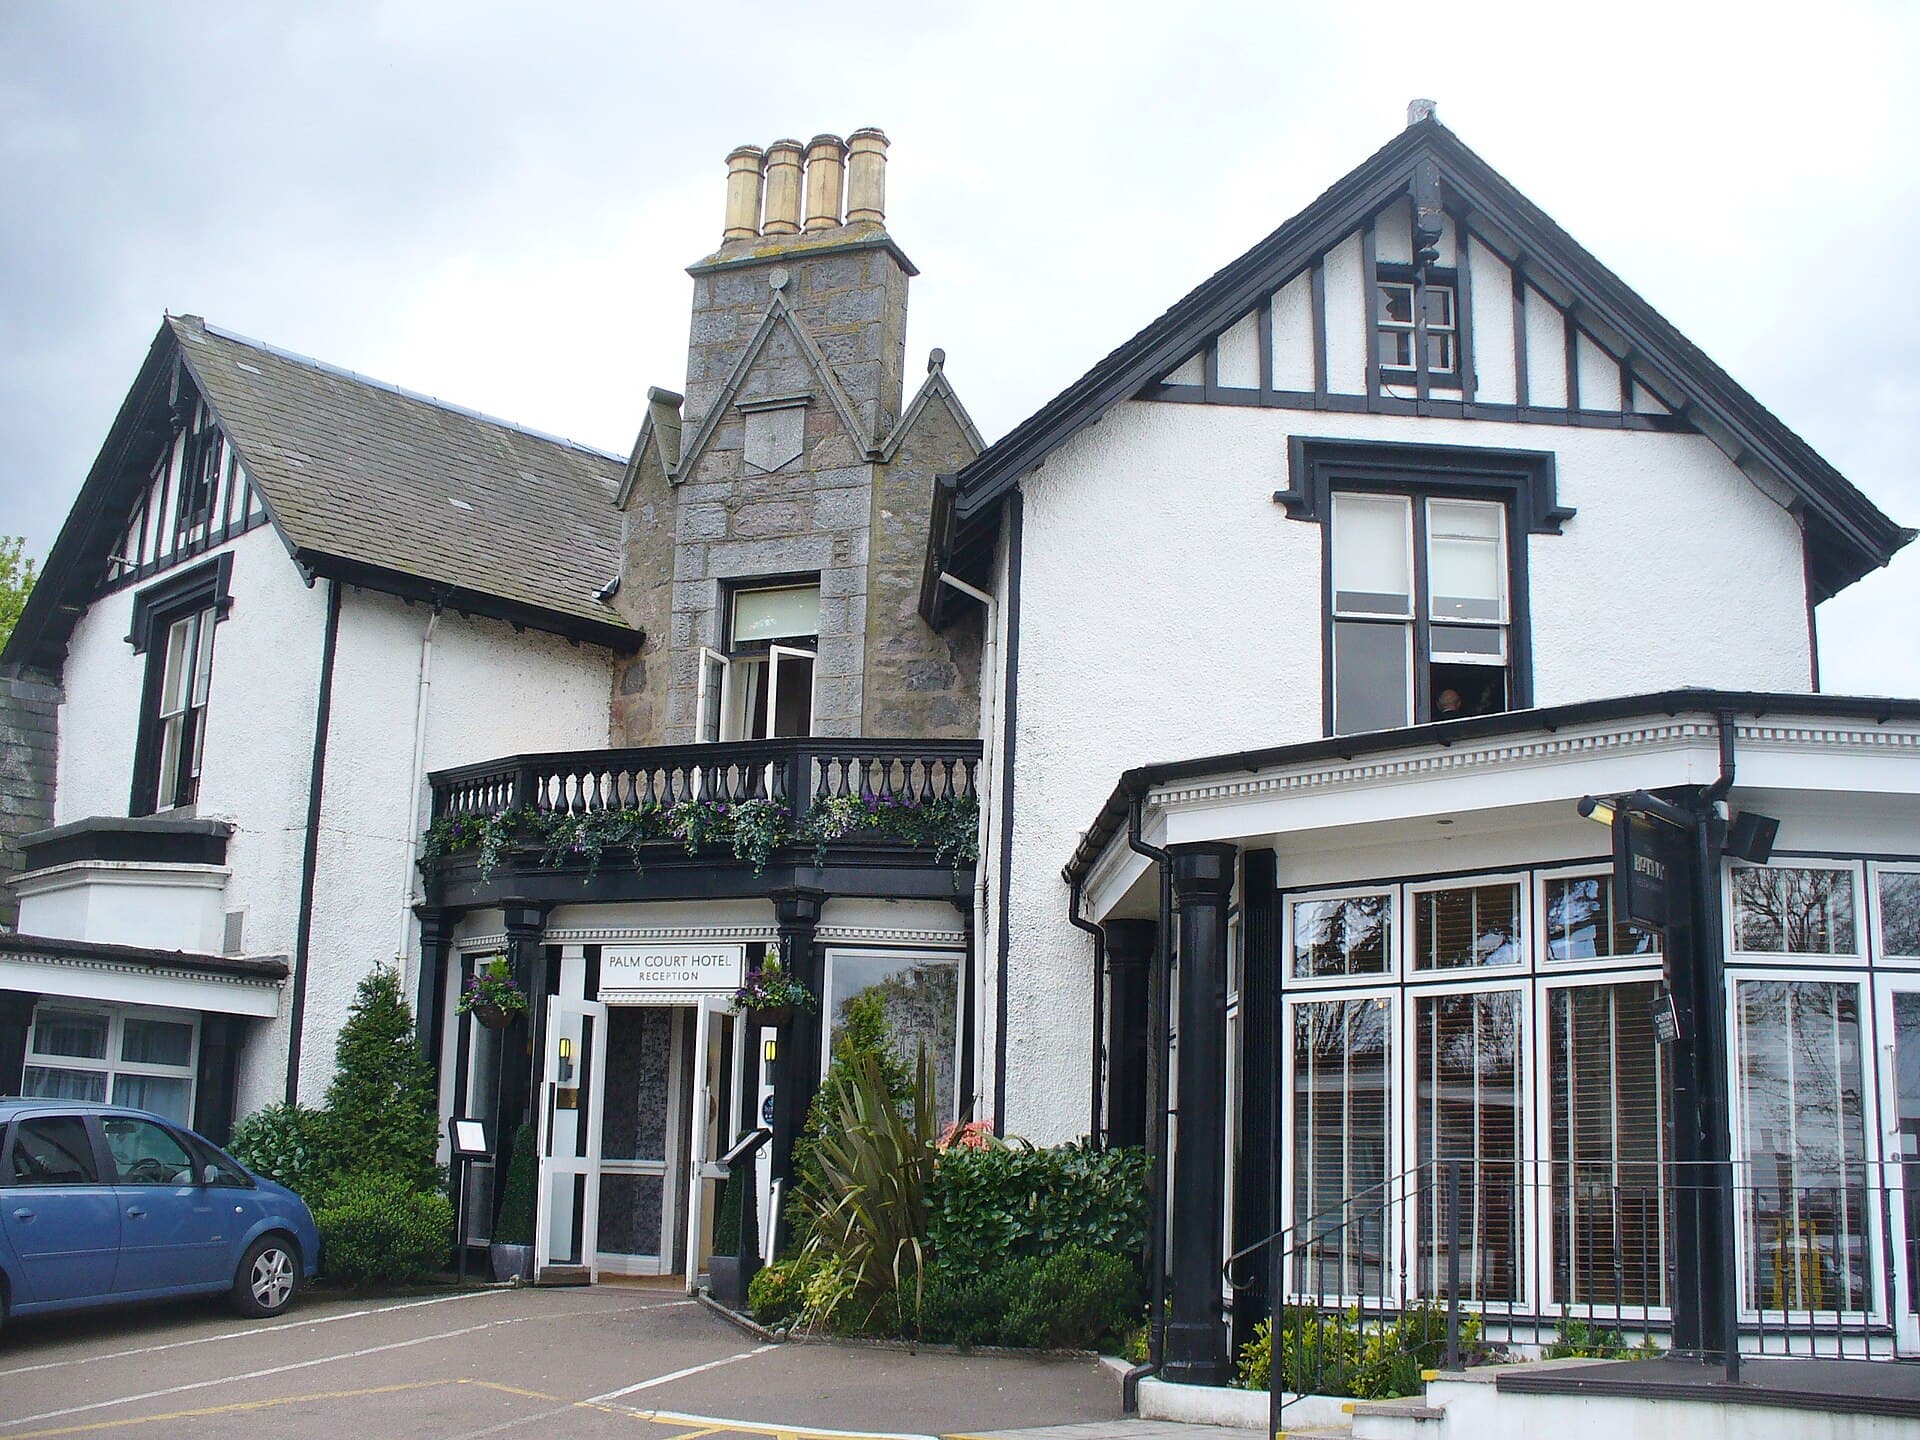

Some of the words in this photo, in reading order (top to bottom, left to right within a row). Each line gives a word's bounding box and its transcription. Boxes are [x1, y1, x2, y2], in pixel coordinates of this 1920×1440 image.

[609, 956, 640, 967] PALM
[644, 955, 688, 967] COURT
[691, 954, 732, 967] HOTEL
[639, 971, 699, 981] RECEPTION
